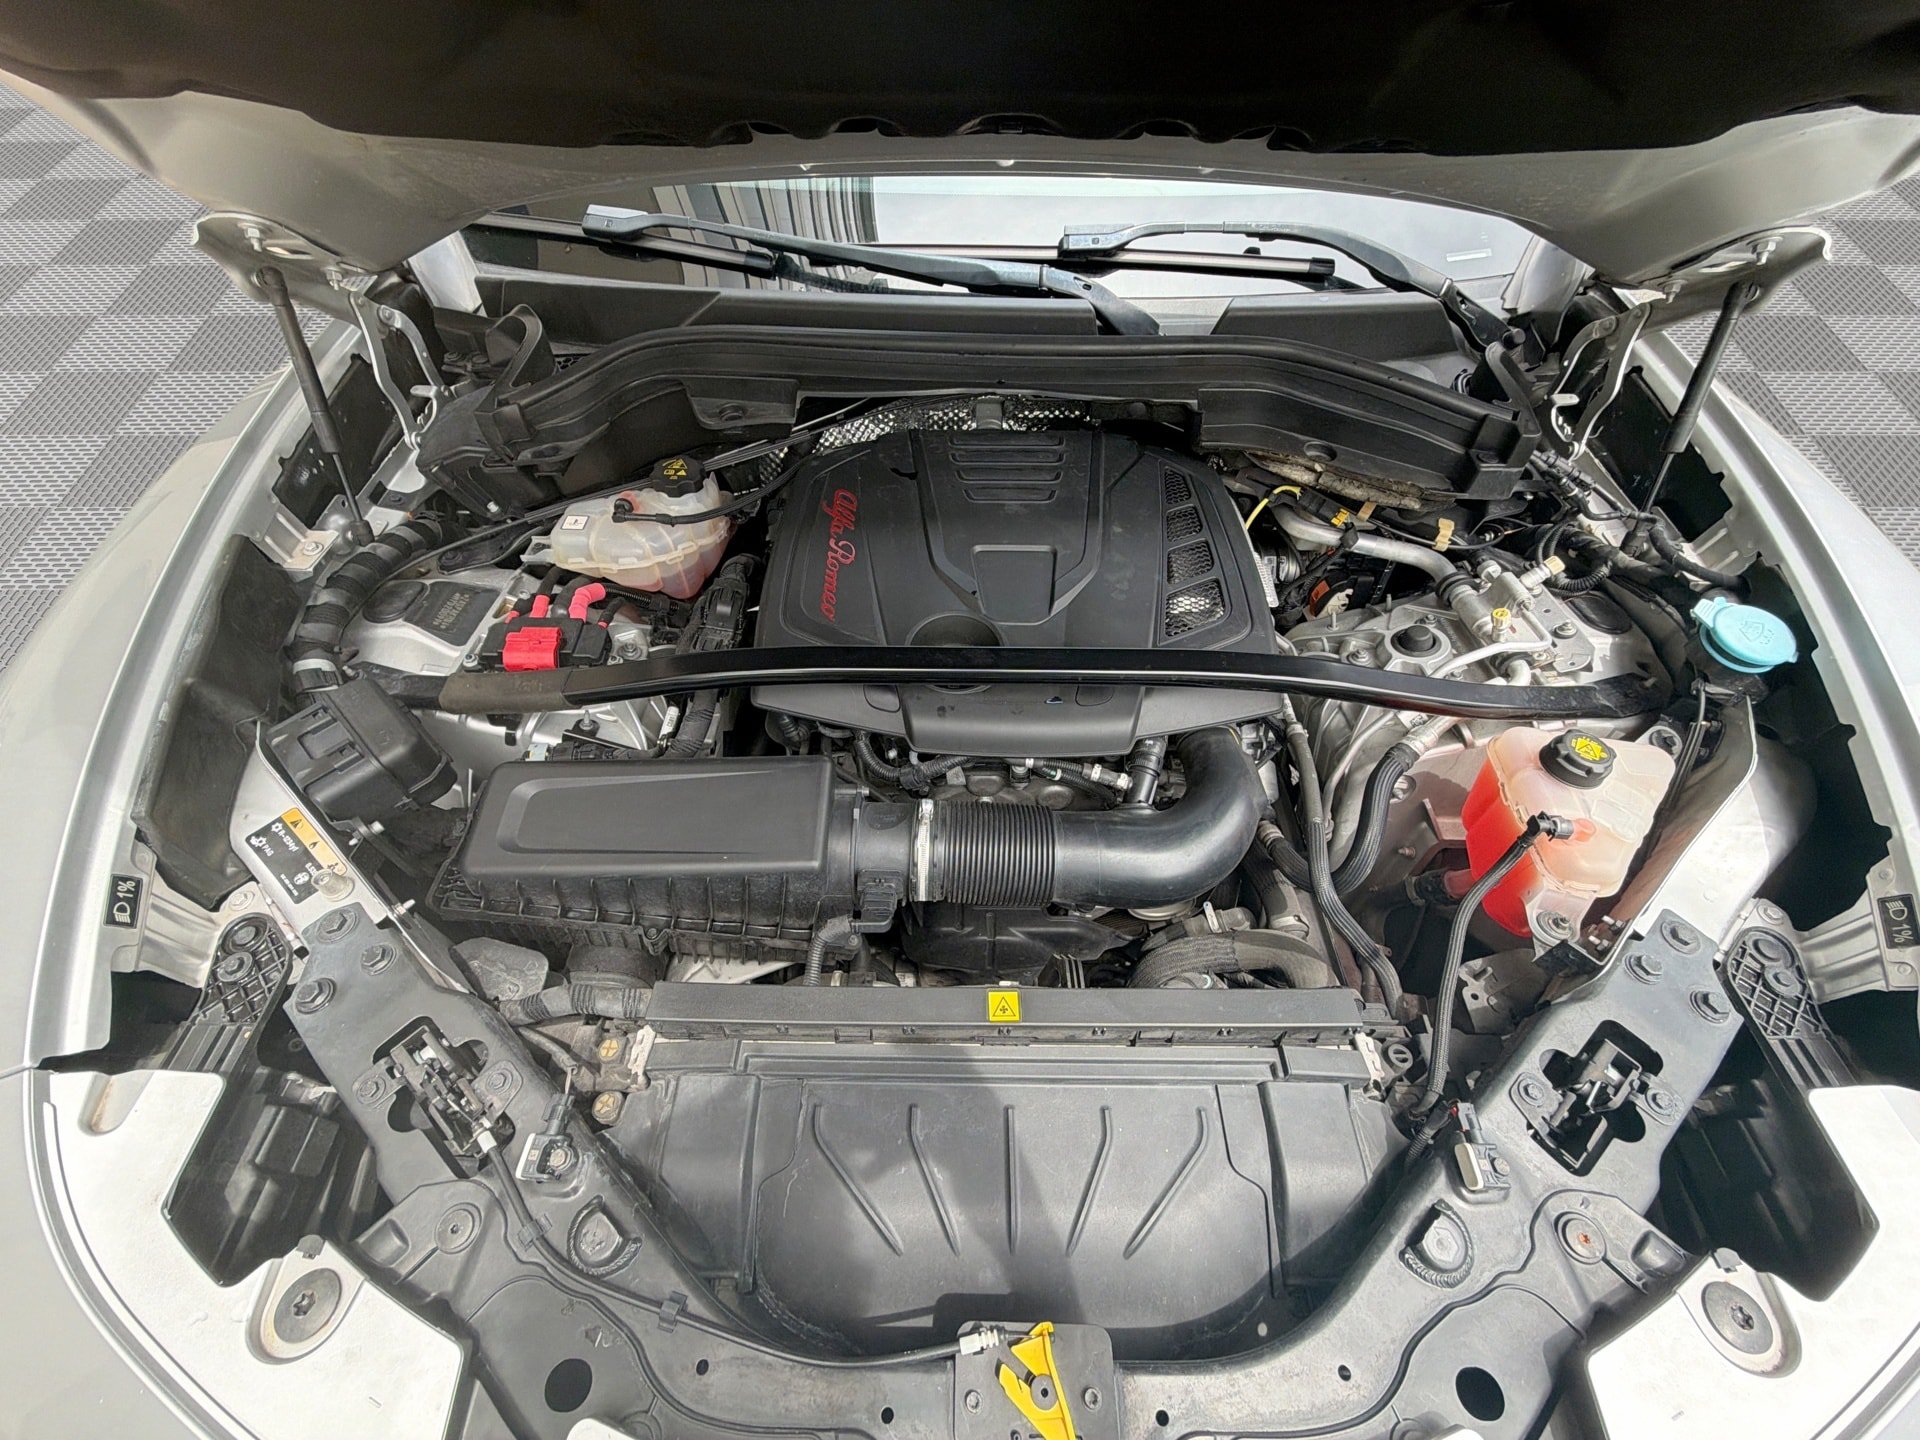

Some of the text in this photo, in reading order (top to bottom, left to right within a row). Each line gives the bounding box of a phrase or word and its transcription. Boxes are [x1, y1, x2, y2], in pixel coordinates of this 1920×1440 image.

[820, 488, 858, 623] Alfa Romeo
[261, 844, 275, 857] PAG
[116, 880, 136, 898] 1%
[1892, 923, 1914, 943] 1%
